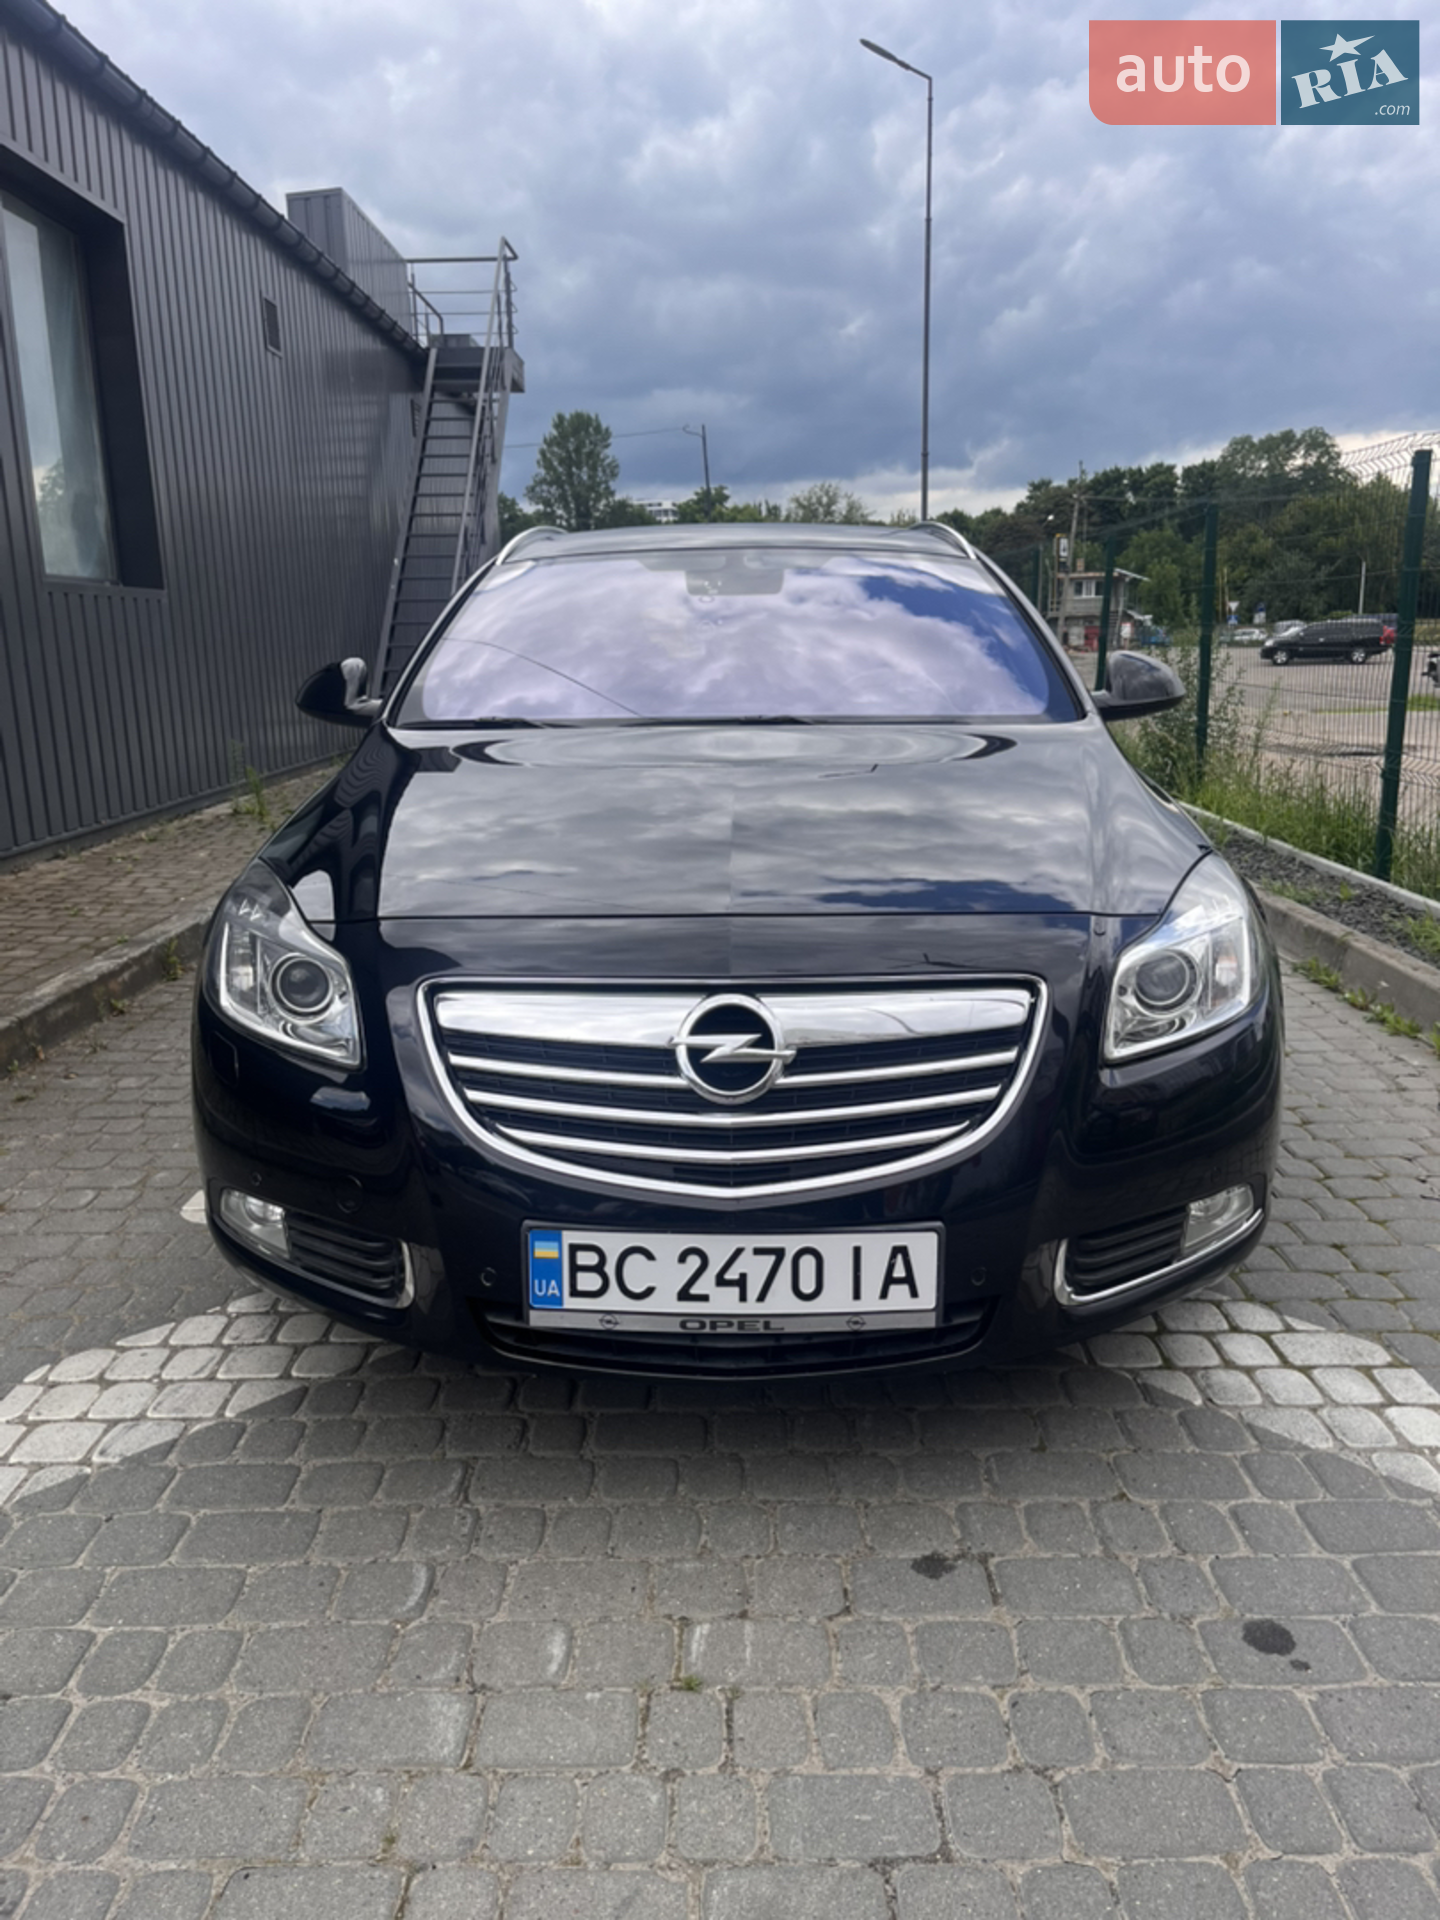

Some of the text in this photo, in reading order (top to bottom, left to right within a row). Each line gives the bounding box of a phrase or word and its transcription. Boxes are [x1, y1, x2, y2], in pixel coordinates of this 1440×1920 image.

[568, 1243, 920, 1303] BC 2470 IA
[534, 1279, 560, 1297] UA
[679, 1319, 785, 1332] OPEL
